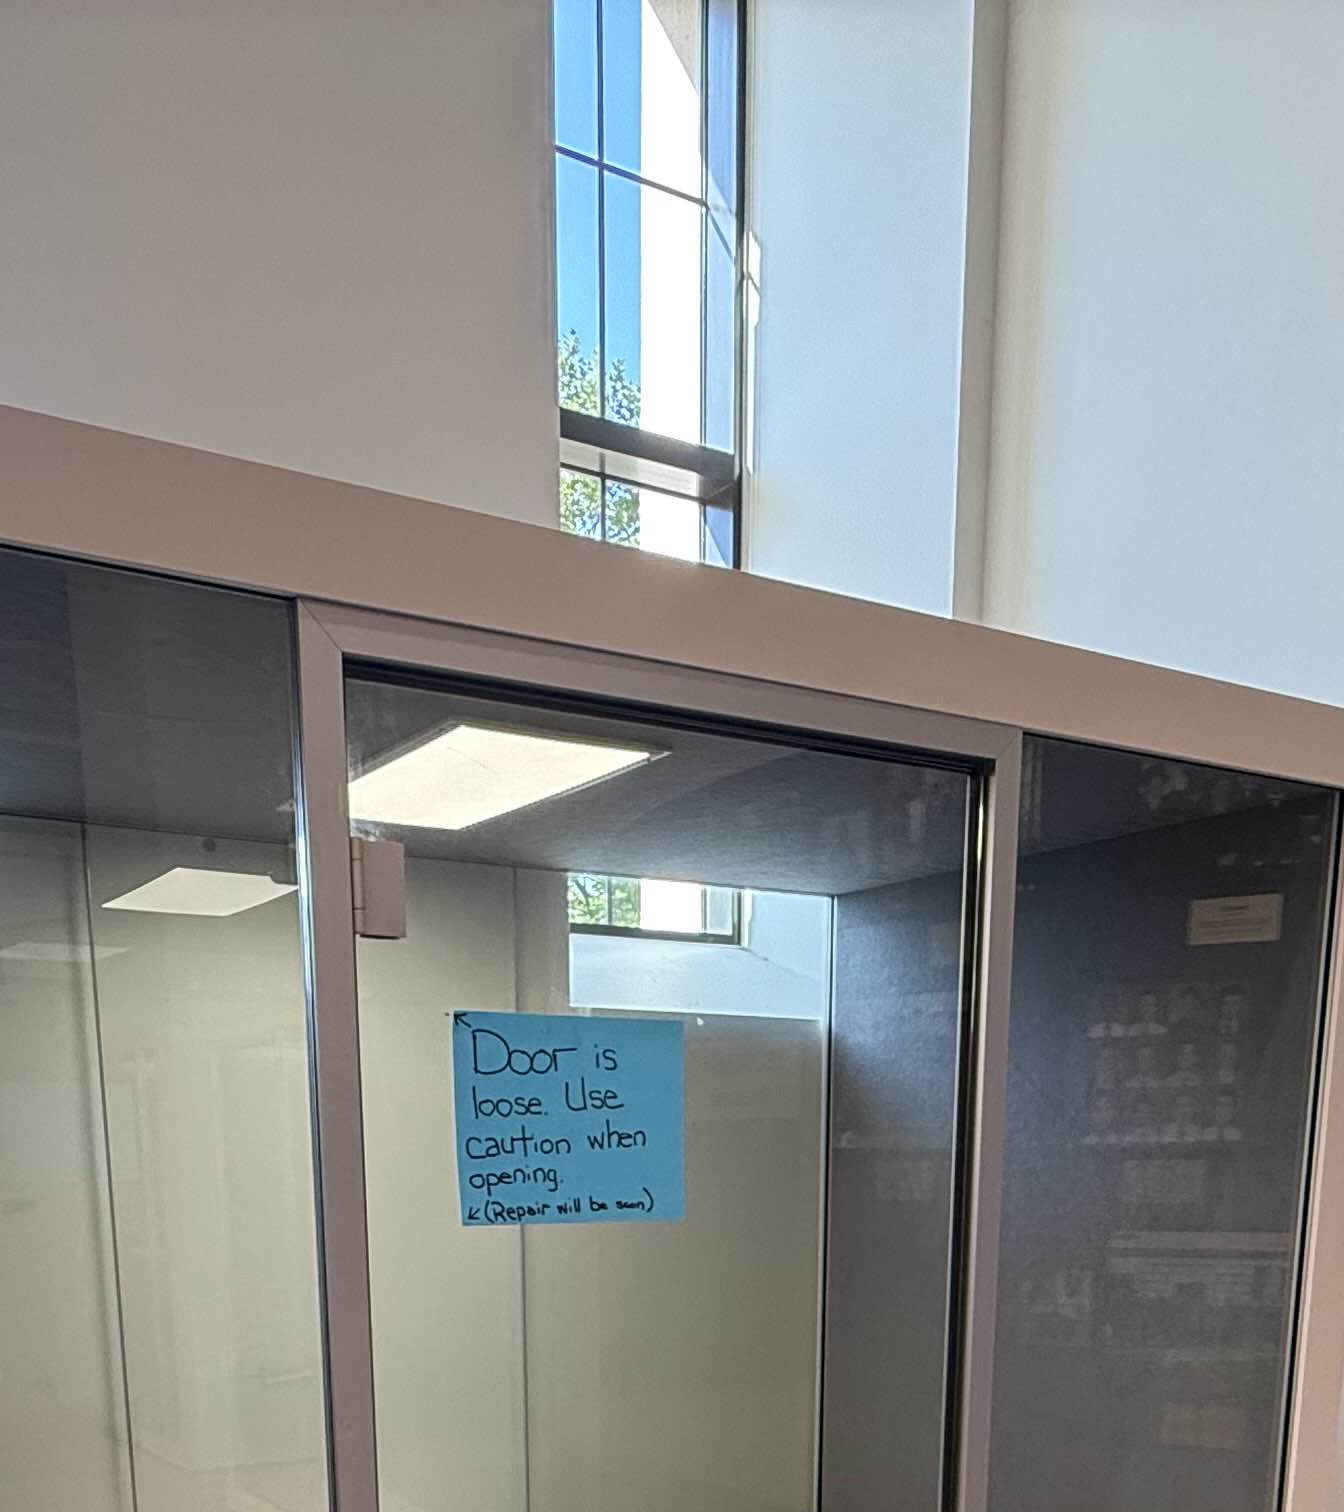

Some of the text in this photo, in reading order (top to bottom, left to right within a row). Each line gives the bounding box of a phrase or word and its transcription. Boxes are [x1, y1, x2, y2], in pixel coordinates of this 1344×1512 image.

[471, 1028, 618, 1075] Door is
[472, 1076, 625, 1119] loose. Use
[465, 1119, 647, 1160] caution when
[468, 1165, 565, 1197] opening.
[484, 1199, 552, 1224] (Repair
[556, 1196, 582, 1216] will
[588, 1195, 609, 1212] be
